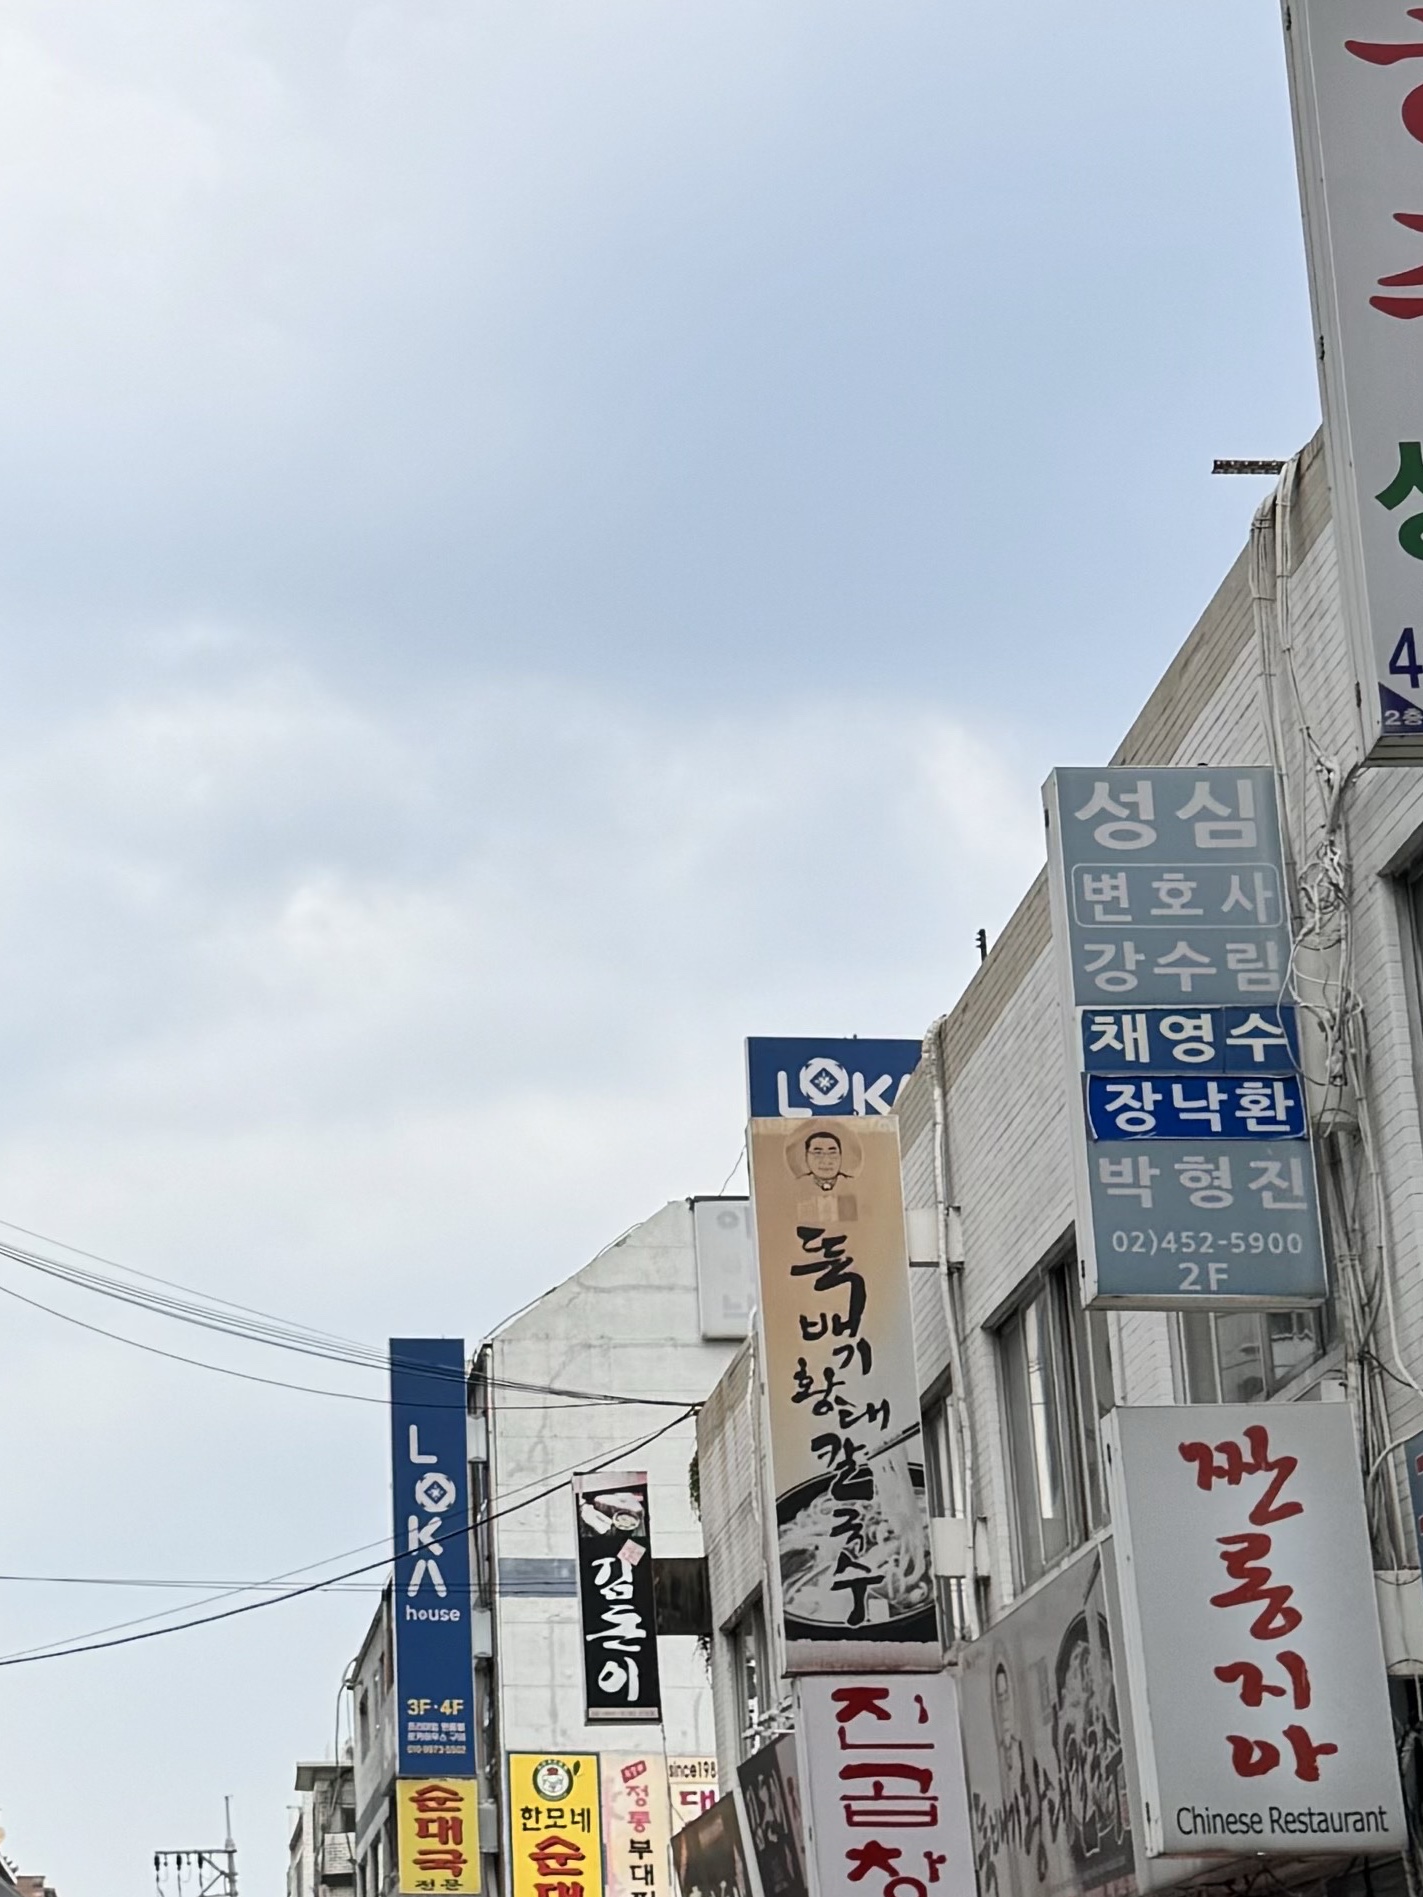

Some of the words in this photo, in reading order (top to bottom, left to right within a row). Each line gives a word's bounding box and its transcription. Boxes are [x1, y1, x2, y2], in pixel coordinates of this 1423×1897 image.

[1074, 778, 1257, 850] 성심
[1082, 871, 1273, 924] 변호사
[1082, 941, 1280, 994] 강수림
[1089, 1012, 1288, 1064] 채영수
[1106, 1081, 1295, 1133] 장낙환
[1098, 1155, 1307, 1210] 박형진
[1112, 1231, 1302, 1257] 02)452-5900
[1178, 1262, 1229, 1292] 2F
[405, 1605, 461, 1622] house
[409, 1784, 468, 1877] 순대국
[520, 1807, 591, 1833] 한모네
[1176, 1806, 1264, 1836] Chinese
[1270, 1804, 1389, 1834] Restaurant
